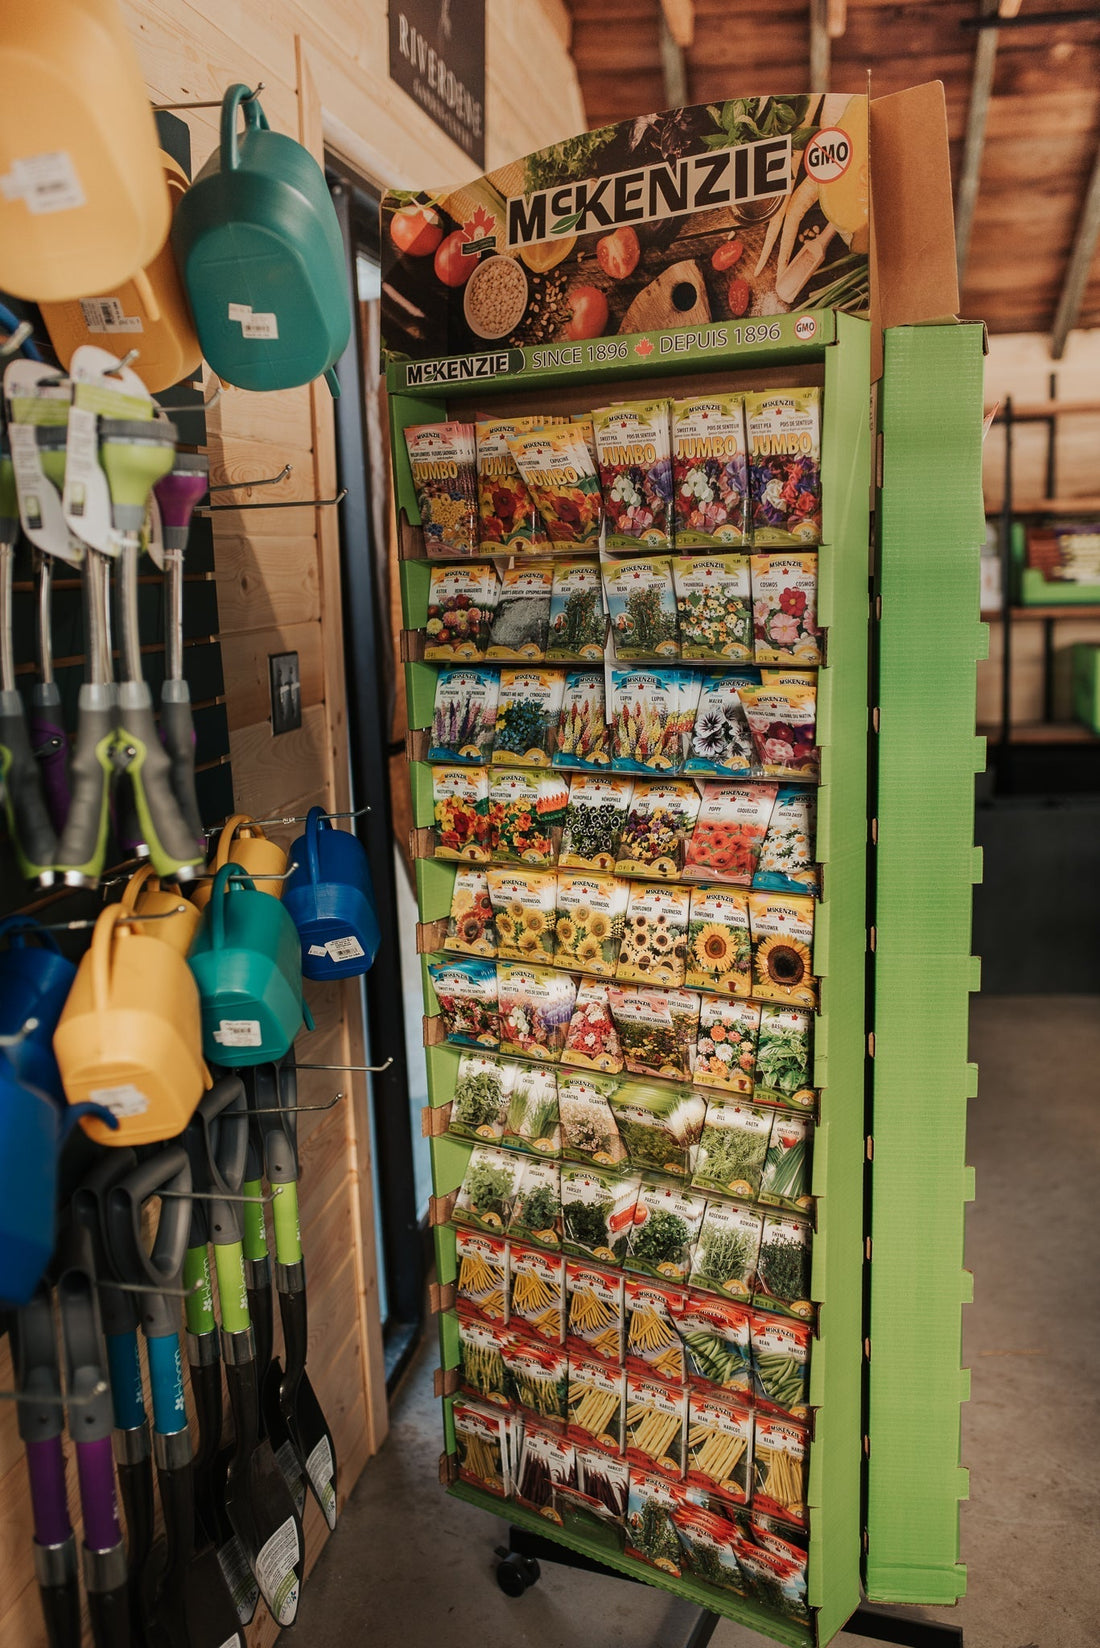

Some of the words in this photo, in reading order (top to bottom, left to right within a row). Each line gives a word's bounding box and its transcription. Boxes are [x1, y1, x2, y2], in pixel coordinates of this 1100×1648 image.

[808, 141, 848, 168] GMO
[796, 321, 815, 333] GMO
[533, 348, 582, 369] SINCE
[587, 341, 628, 362] 1896
[660, 329, 728, 353] DEPUIS
[734, 323, 781, 344] 1896
[676, 435, 737, 459] JUMBO
[752, 432, 812, 457] JUMBO
[602, 444, 656, 466] JUMBO
[414, 460, 459, 480] JUMBO
[480, 456, 518, 476] JUMB
[525, 466, 578, 486] JUMBO
[589, 900, 610, 908] TOURNESOL
[661, 908, 682, 916] TOURNESOL
[724, 915, 745, 923] TOURNESOL
[755, 923, 778, 931] SUNFLOWER
[789, 927, 813, 935] TOURNESOL
[741, 1013, 755, 1021] ZINNIA
[644, 1196, 660, 1205] PARSLEY
[708, 1212, 729, 1221] ROSEMARY
[758, 1339, 770, 1347] BEAN
[634, 1394, 645, 1402] BEAN
[659, 1402, 675, 1412] HARICOT
[697, 1415, 708, 1423] BEAN
[723, 1424, 740, 1433] HARICOT
[763, 1437, 775, 1445] BEAN
[607, 1464, 623, 1473] HARICOT
